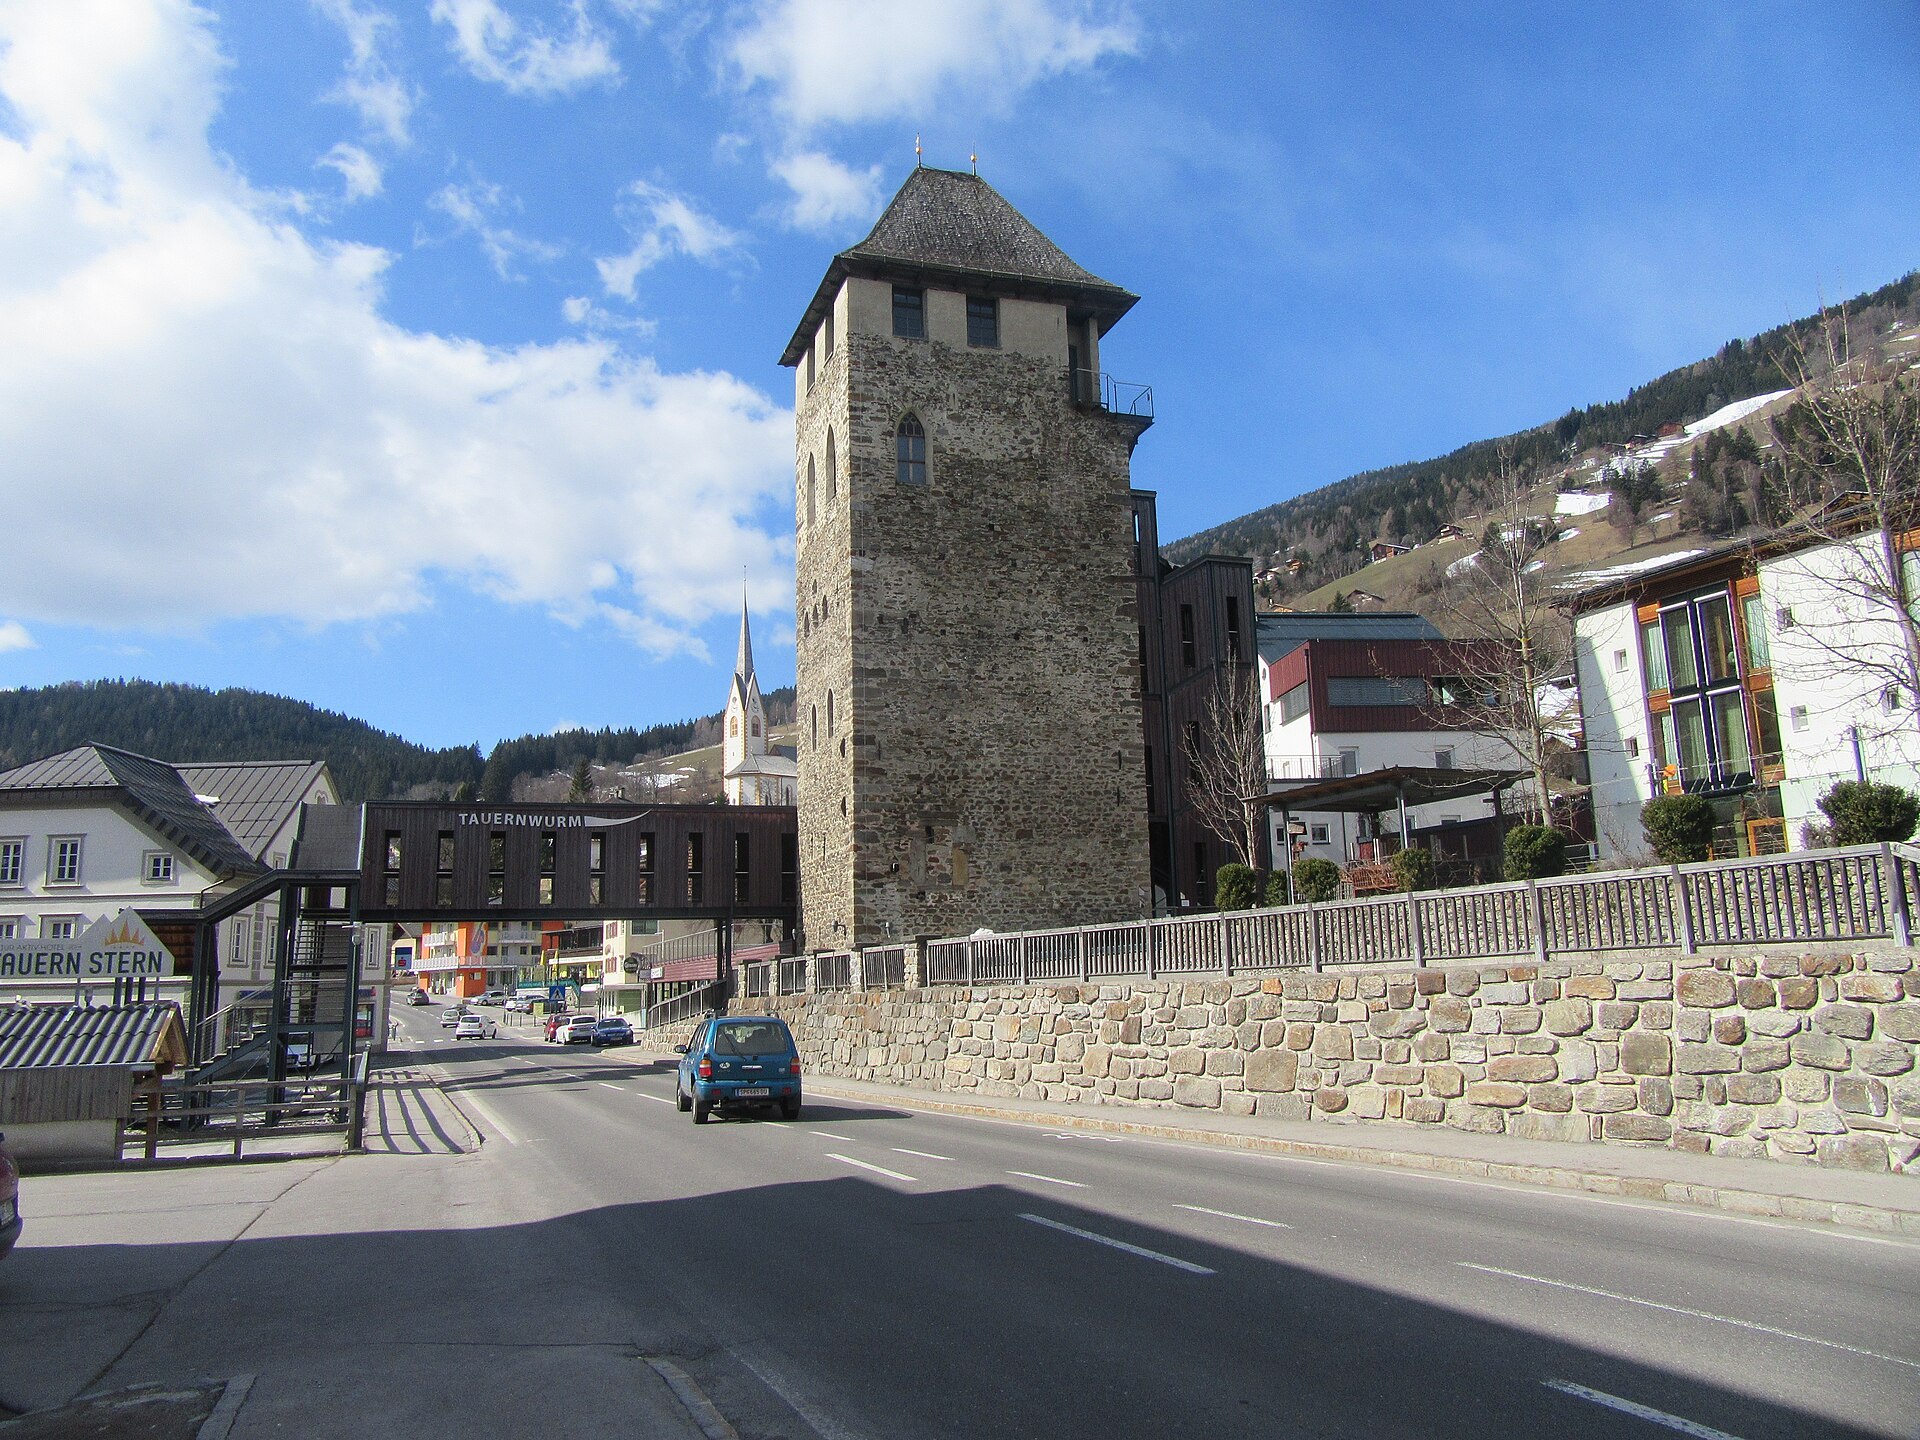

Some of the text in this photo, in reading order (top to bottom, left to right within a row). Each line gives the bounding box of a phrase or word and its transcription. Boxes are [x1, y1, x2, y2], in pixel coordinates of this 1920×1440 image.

[458, 812, 582, 829] TAUERNWURM
[0, 951, 164, 975] AUERN STERN
